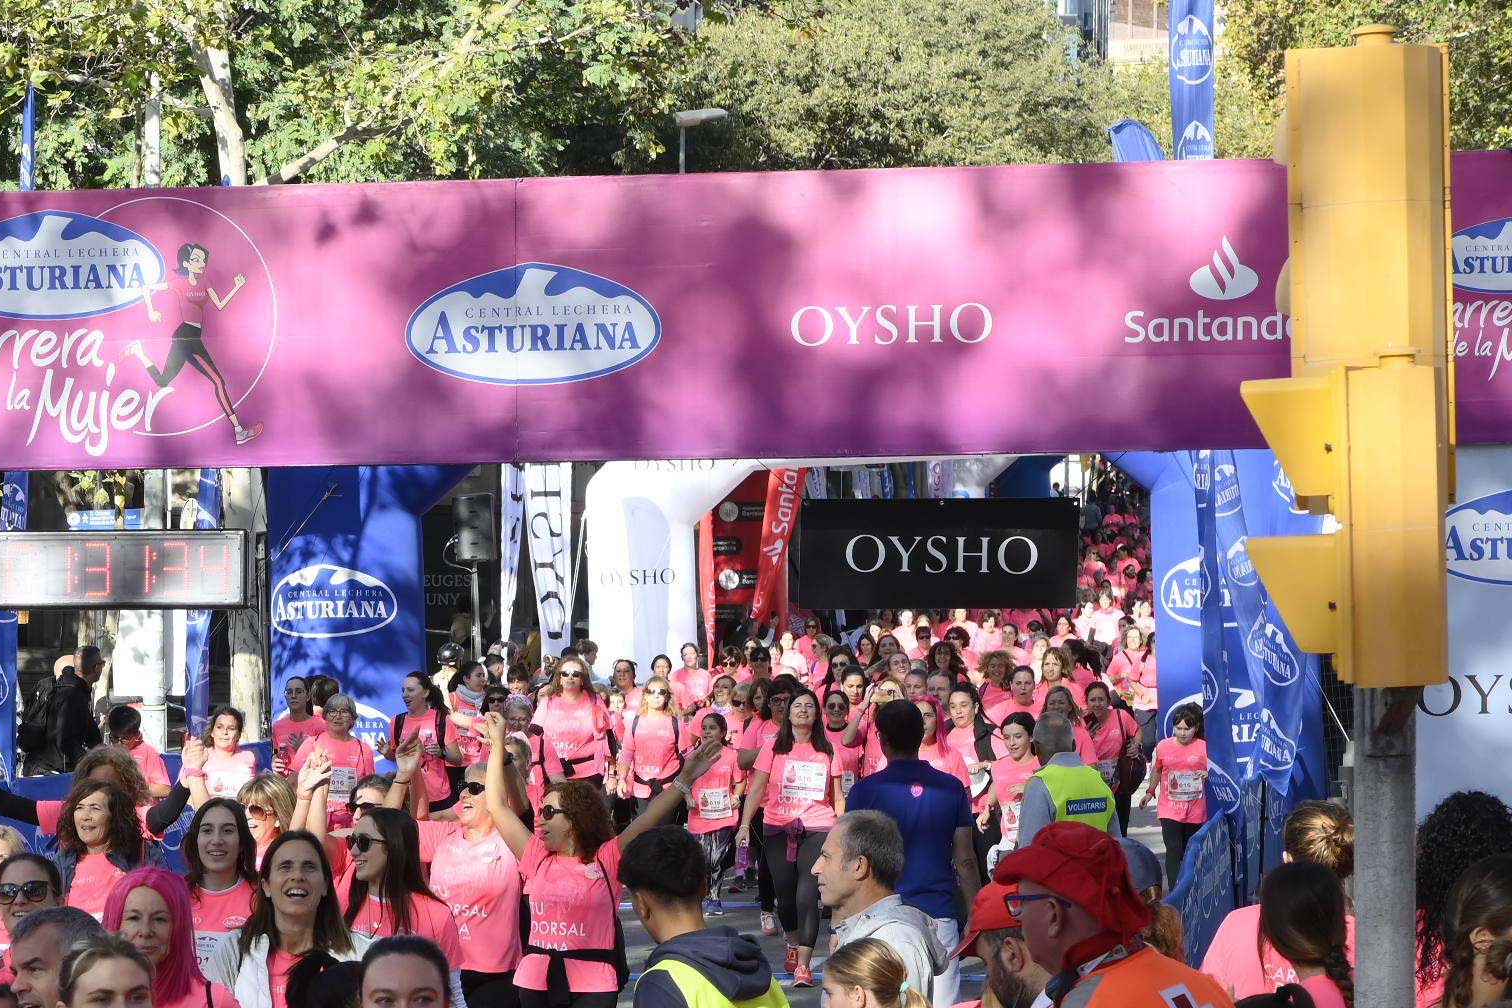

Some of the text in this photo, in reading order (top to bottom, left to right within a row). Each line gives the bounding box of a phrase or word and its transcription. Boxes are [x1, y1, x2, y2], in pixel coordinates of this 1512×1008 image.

[68, 246, 141, 259] LECHERA
[465, 302, 633, 319] CENTRAL LECHERA
[791, 302, 993, 347] OYSHO
[1124, 310, 1291, 344] Santand
[425, 310, 642, 355] ASTURIANA
[1475, 329, 1492, 357] la
[7, 372, 31, 411] la
[25, 364, 176, 457] Mujer
[530, 463, 566, 640] OYSH
[845, 534, 1039, 575] OYSHO
[288, 589, 383, 598] CENTRAL LECHERA
[600, 567, 676, 586] OYSHO
[274, 595, 388, 622] ASTURIANA
